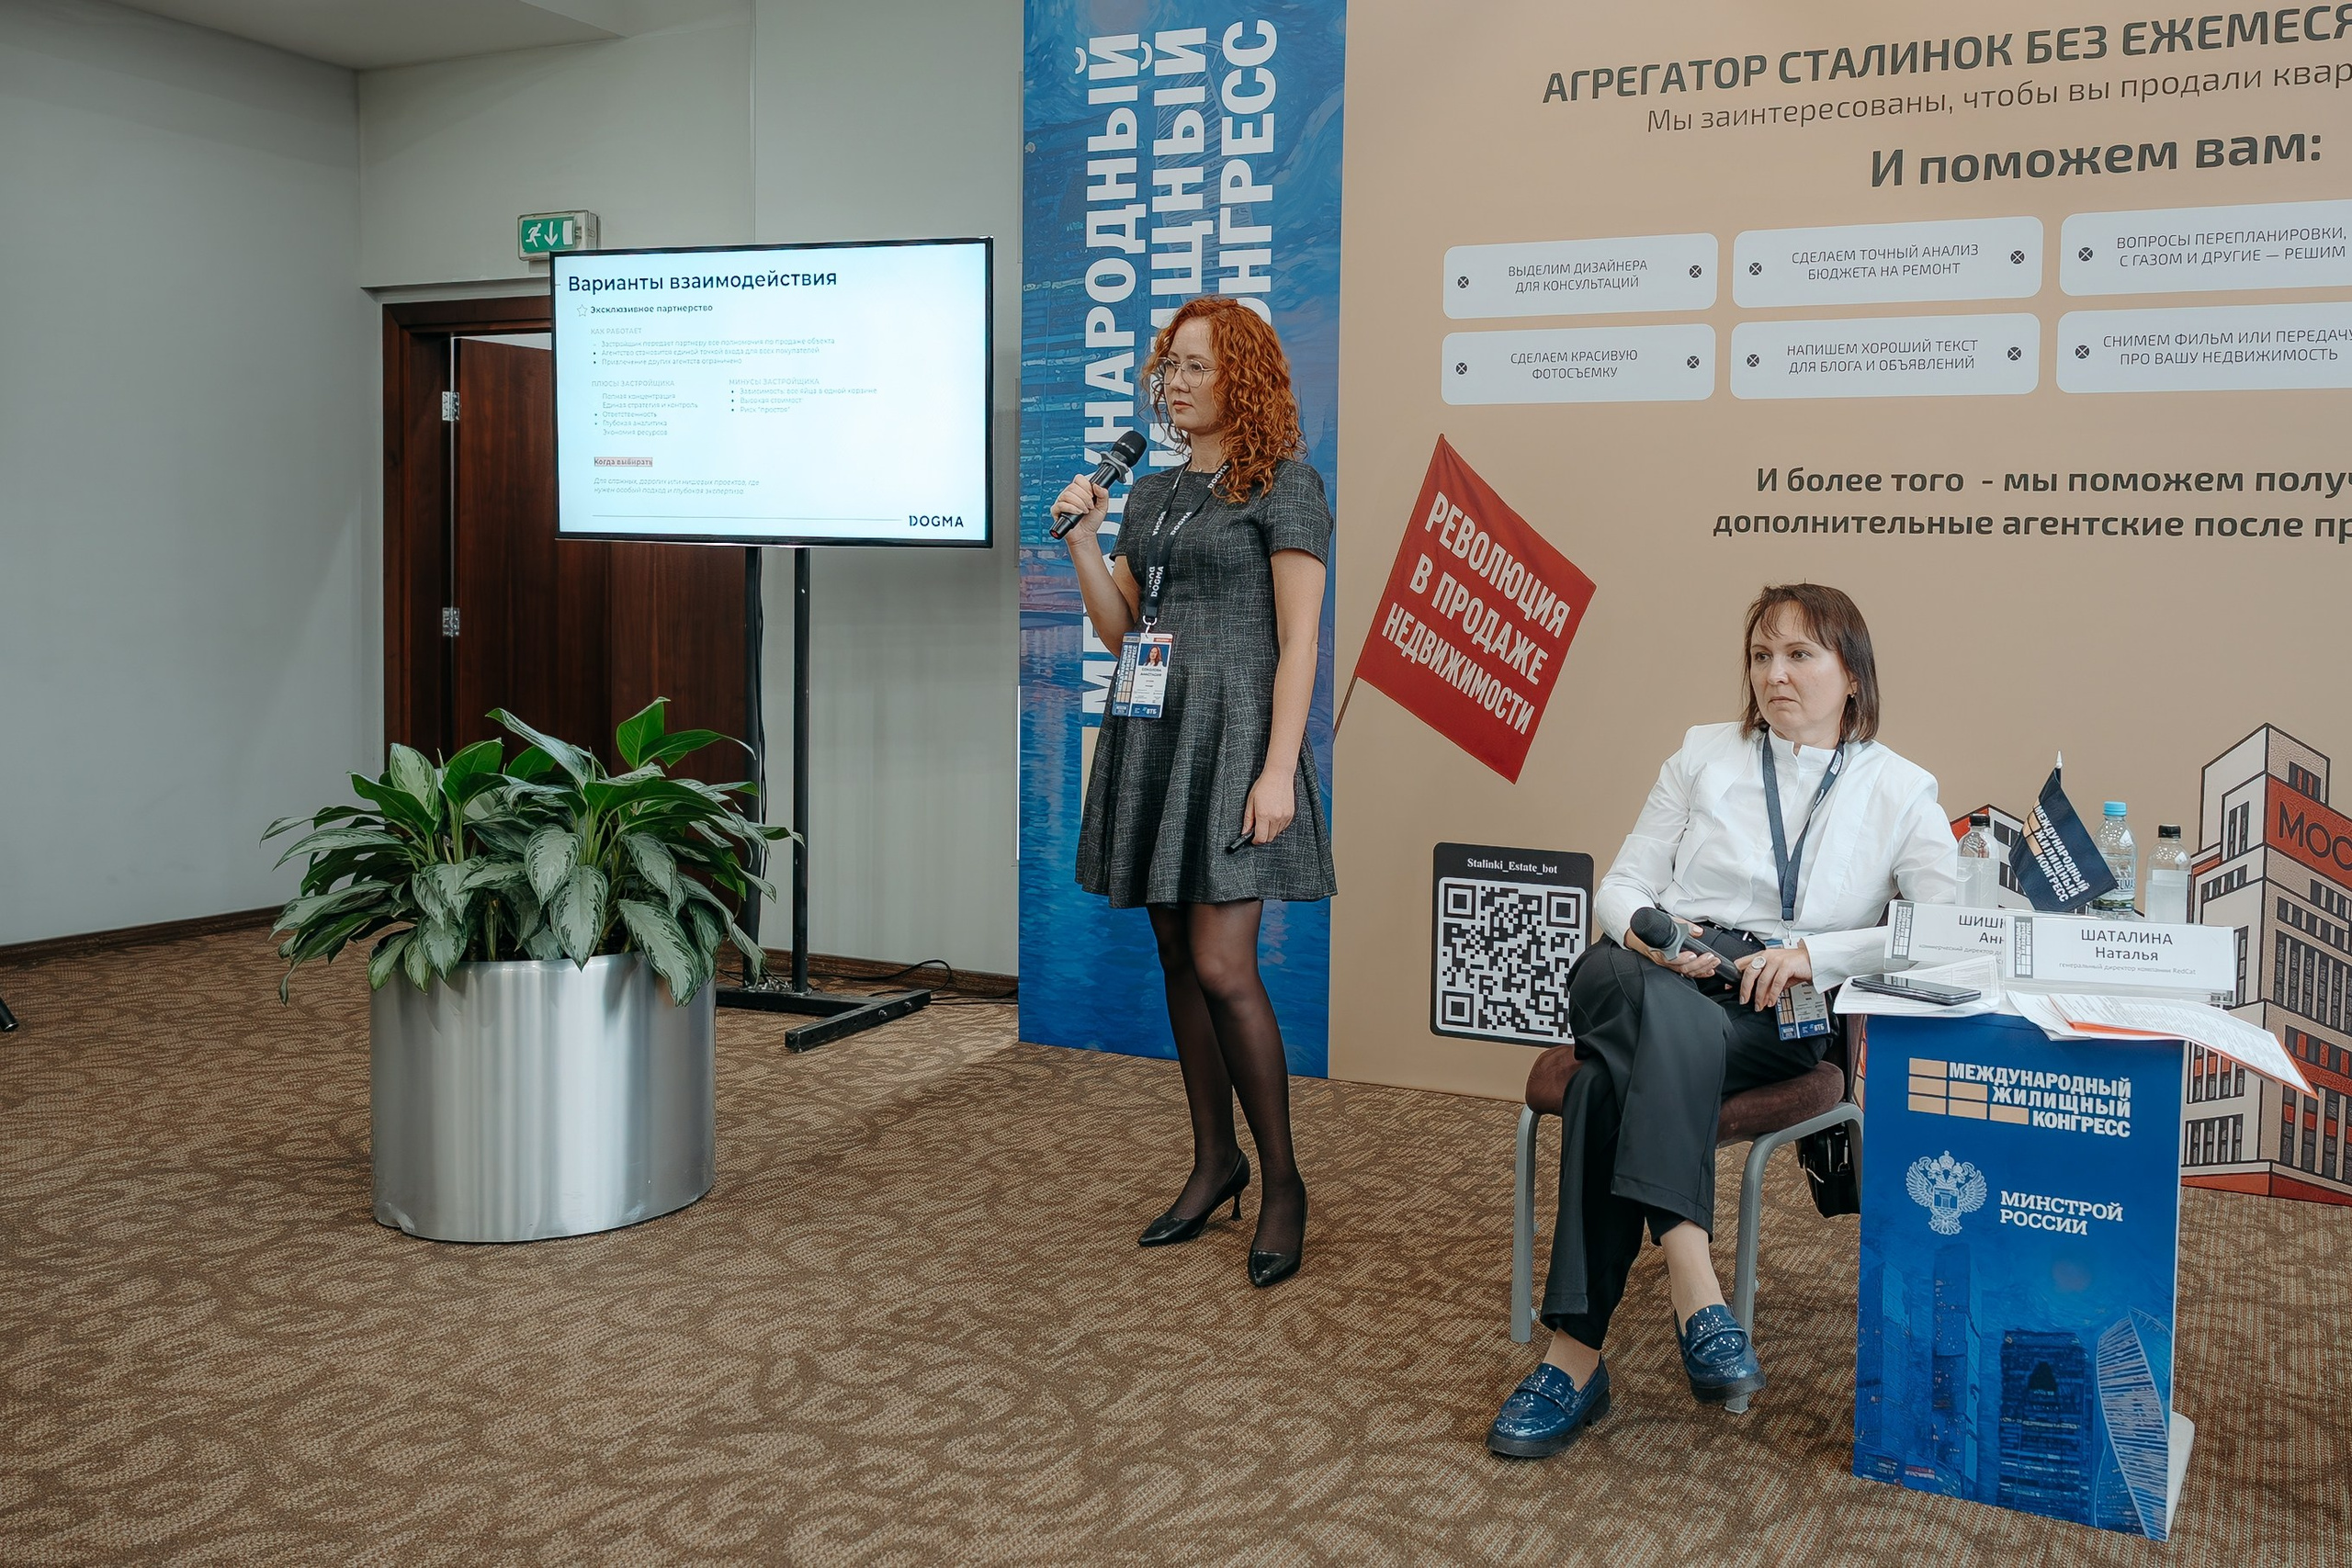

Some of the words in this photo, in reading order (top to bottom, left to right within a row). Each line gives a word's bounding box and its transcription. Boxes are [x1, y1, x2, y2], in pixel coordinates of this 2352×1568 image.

[1542, 53, 1768, 104] АГРЕГАТОР
[1779, 32, 2014, 84] СТАЛИНОК
[2026, 25, 2109, 65] БЕЗ
[1647, 108, 1692, 133] Мы
[1701, 93, 1954, 129] заинтересованы,
[1963, 79, 2058, 109] чтобы
[2068, 81, 2109, 101] вы
[2120, 69, 2262, 103] продали
[1871, 149, 1905, 188] И
[1919, 141, 2178, 186] поможем
[2195, 132, 2323, 170] вам:
[2116, 234, 2191, 249] ВОПРОСЫ
[2195, 226, 2347, 246] ПЕРЕПЛАНИРОВКИ,
[1791, 249, 1856, 265] СДЕЛАЕМ
[1860, 245, 1918, 262] ТОЧНЫЙ
[1921, 243, 1979, 258] АНАЛИЗ
[2120, 254, 2129, 267] С
[2132, 253, 2183, 267] ГАЗОМ
[2187, 252, 2198, 265] И
[2200, 249, 2261, 265] ДРУГИЕ
[2284, 245, 2346, 260] РЕШИМ
[1508, 263, 1571, 277] ВЫДЕЛИМ
[1573, 259, 1648, 276] ДИЗАЙНЕРА
[1808, 266, 1877, 281] БЮДЖЕТА
[1880, 265, 1899, 277] НА
[1903, 263, 1961, 276] РЕМОНТ
[569, 276, 663, 295] Варианты
[670, 270, 837, 290] взаимодействия
[1515, 280, 1540, 294] ДЛЯ
[1543, 275, 1639, 292] КОНСУЛЬТАЦИЙ
[590, 305, 654, 314] Эксклюзивное
[656, 305, 713, 314] партнерство
[1787, 343, 1858, 356] НАПИШЕМ
[1860, 338, 1932, 355] ХОРОШИЙ
[1935, 339, 1978, 353] ТЕКСТ
[2103, 333, 2171, 348] СНИМЕМ
[2174, 332, 2233, 346] ФИЛЬМ
[2238, 331, 2271, 344] ИЛИ
[1510, 352, 1568, 365] СДЕЛАЕМ
[1571, 349, 1638, 363] КРАСИВУЮ
[1788, 361, 1816, 375] ДЛЯ
[1820, 360, 1863, 373] БЛОГА
[1866, 359, 1876, 372] И
[1879, 355, 1975, 371] ОБЪЯВЛЕНИЙ
[2120, 352, 2150, 366] ПРО
[2154, 351, 2199, 365] ВАШУ
[2202, 347, 2338, 365] НЕДВИЖИМОСТЬ
[620, 378, 675, 387] ЗАСТРОЙЩИКА
[763, 378, 820, 386] ЗАСТРОЙЩИКА
[1074, 33, 1147, 714] МНАРОДНЫЙ
[1532, 367, 1618, 379] ФОТОСЪЕМКУ
[594, 458, 616, 467] Когда
[616, 458, 652, 467] выбирать
[1207, 464, 1230, 489] DOGMA
[1757, 467, 1778, 492] И
[1787, 466, 1883, 492] более
[1891, 472, 1964, 492] того
[2004, 472, 2057, 492] мы
[2069, 471, 2244, 492] поможем
[2256, 471, 2352, 499] полу
[909, 515, 964, 527] DOGMA
[1170, 511, 1193, 536] DOGMA
[1713, 514, 1994, 536] дополнительные
[2002, 516, 2184, 536] агентские
[2195, 517, 2303, 537] после
[1424, 491, 1571, 638] РЕВОЛЮЦИЯ
[1150, 566, 1164, 597] DOGMA
[1408, 553, 1433, 595] В
[1430, 570, 1549, 685] ПРОДАЖЕ
[1381, 602, 1536, 735] НЕДВИЖИМОСТИ
[2034, 805, 2090, 893] МЕЖДУНАРОДНЫЙ
[1466, 857, 1558, 875] Stalinki_Estate_bot
[2034, 829, 2080, 898] ЖИЛИЩНЫЙ
[2035, 854, 2069, 903] КОНГРЕСС
[2081, 929, 2173, 945] ШАТАЛИНА
[1963, 946, 1994, 955] директор
[2096, 946, 2159, 961] Наталья
[2059, 962, 2103, 970] генеральный
[2103, 964, 2136, 973] директор
[2172, 967, 2196, 976] RedCat
[1949, 1061, 2132, 1099] МЕЖДУНАРОДНЫЙ
[1992, 1086, 2131, 1119] ЖИЛИЩНЫЙ
[2032, 1110, 2132, 1138] КОНГРЕСС
[2000, 1190, 2124, 1223] МИНСТРОЙ
[1999, 1208, 2088, 1236] РОССИИ
